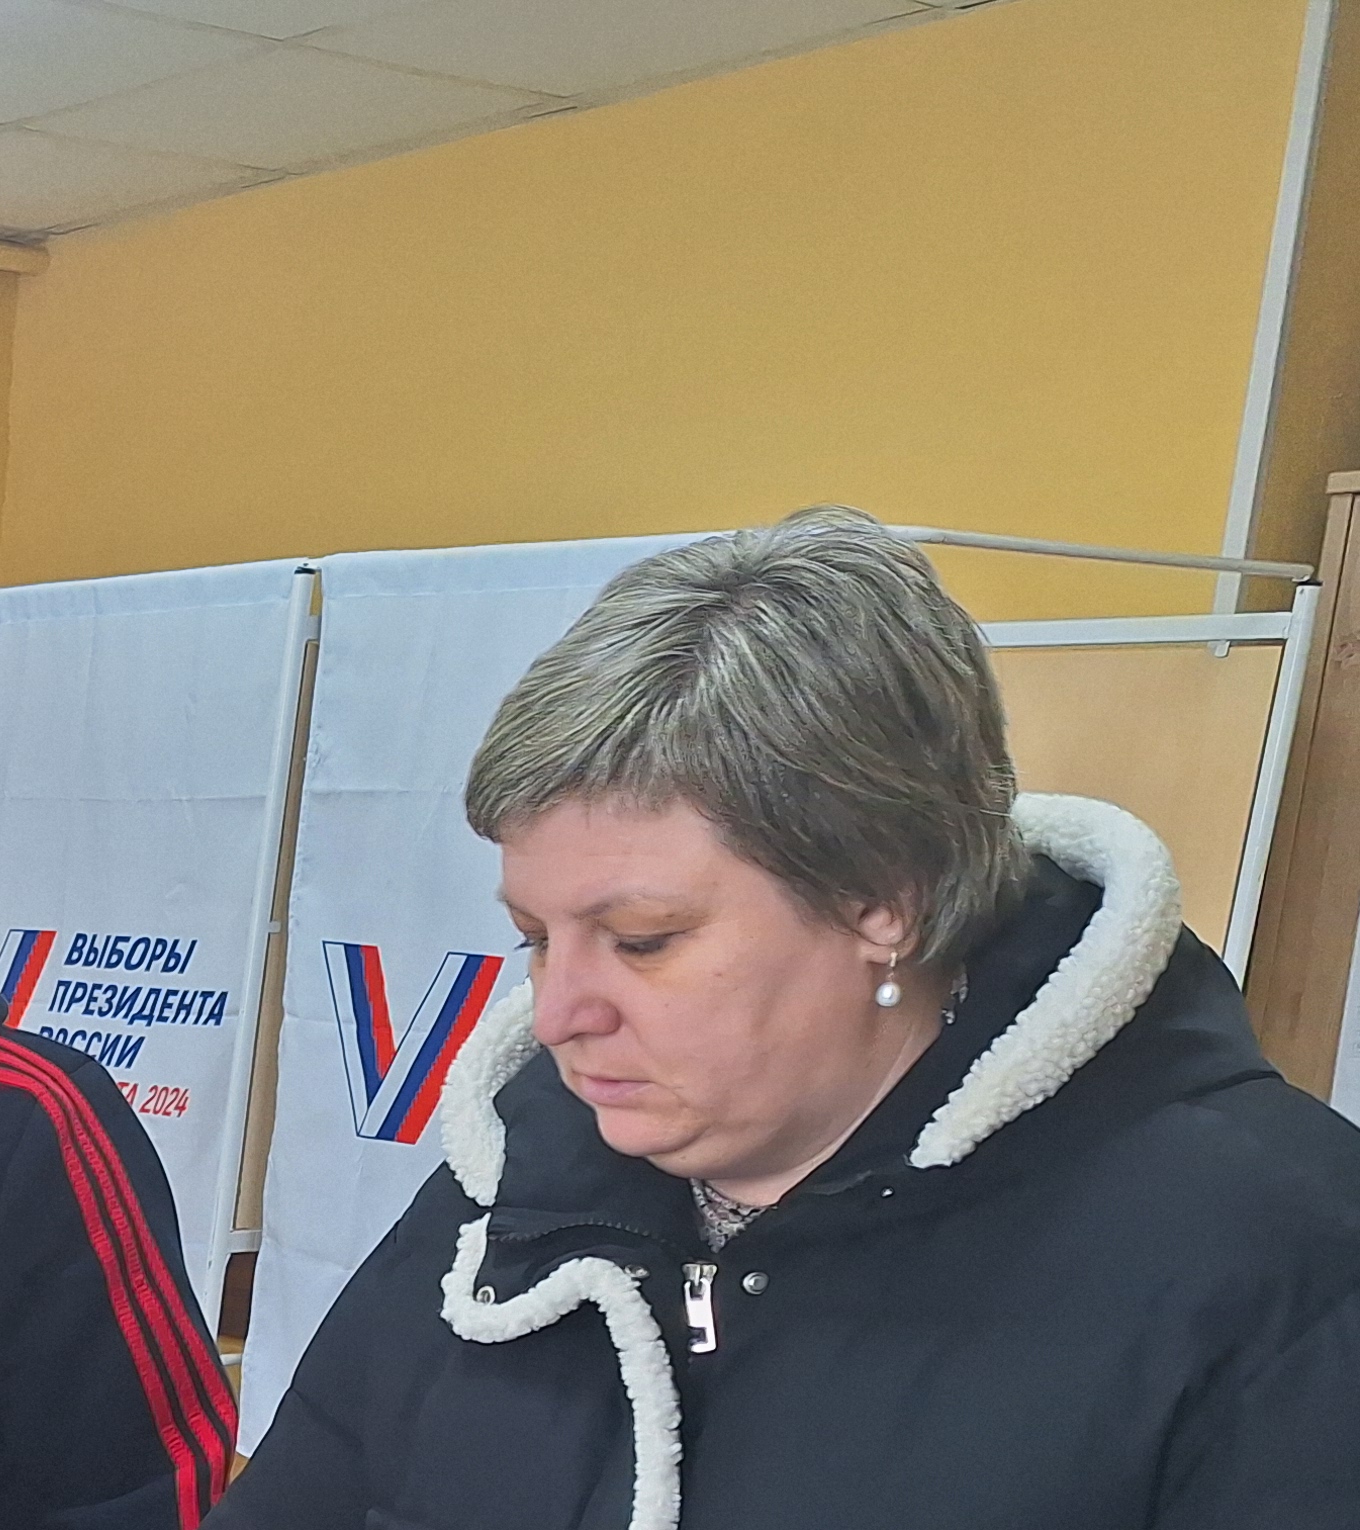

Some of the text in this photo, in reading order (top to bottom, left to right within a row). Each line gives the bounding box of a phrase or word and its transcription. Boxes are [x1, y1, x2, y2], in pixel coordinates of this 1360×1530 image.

[64, 933, 198, 974] ВЫБОРЫ
[48, 979, 228, 1027] ПРЕЗИДЕНТА
[139, 1084, 189, 1118] 2024
